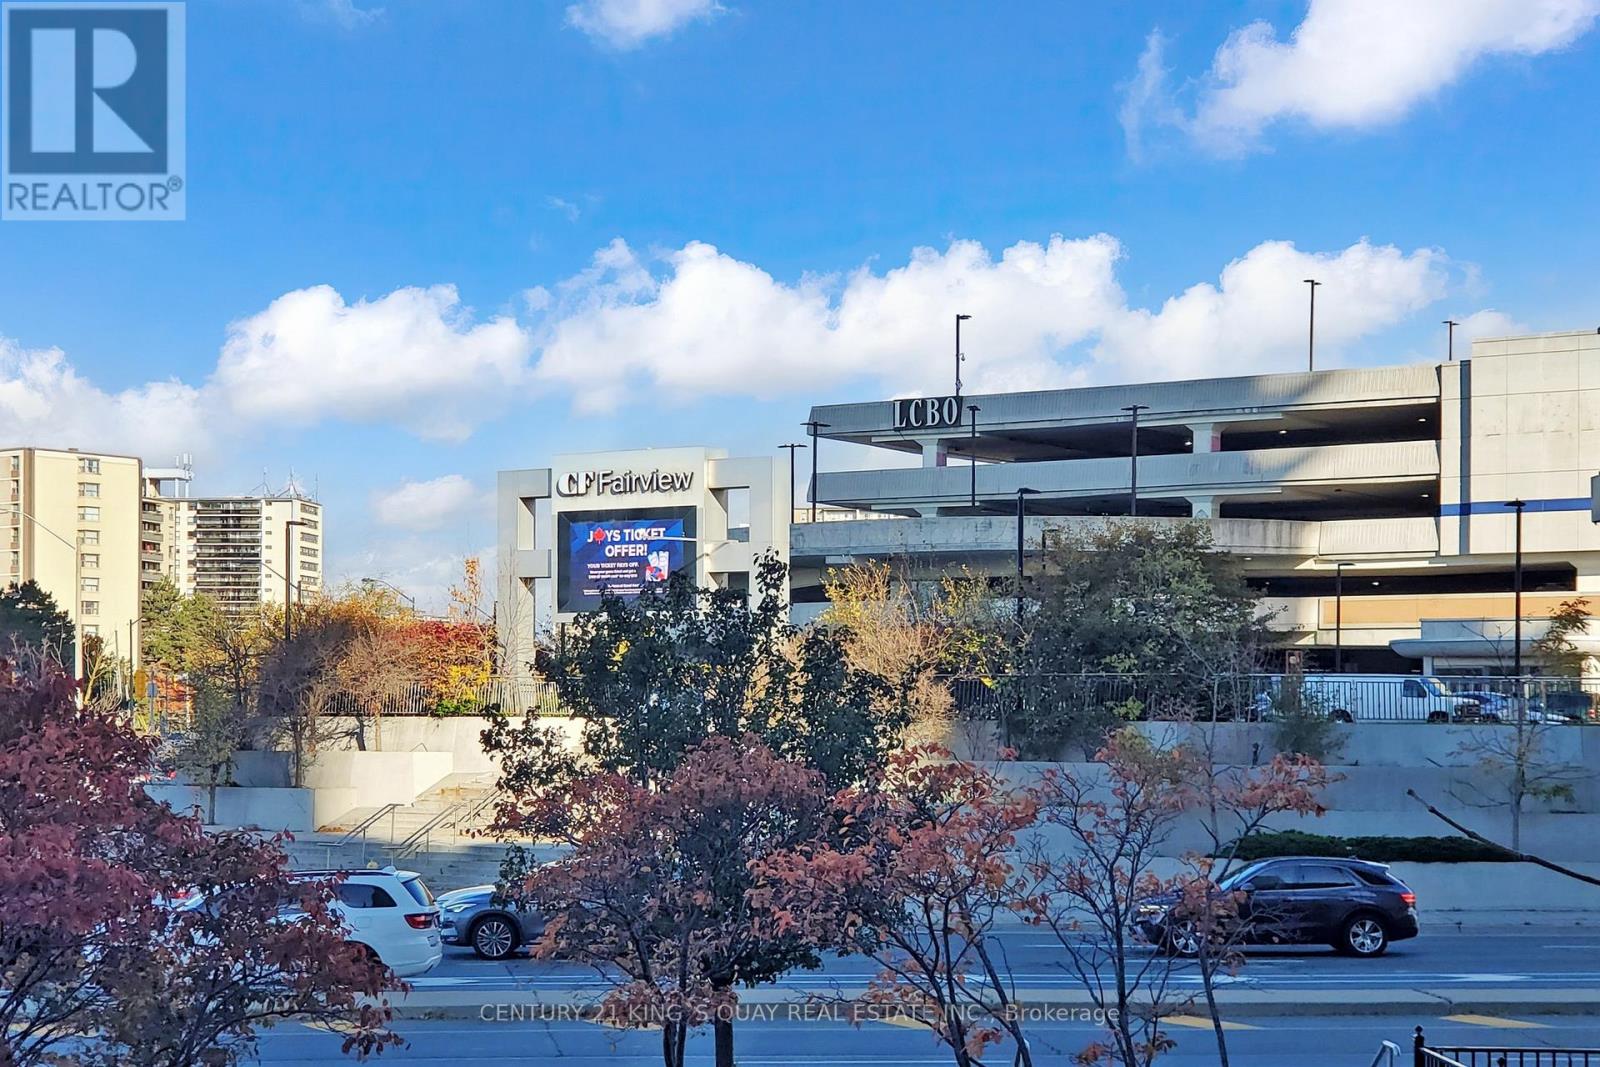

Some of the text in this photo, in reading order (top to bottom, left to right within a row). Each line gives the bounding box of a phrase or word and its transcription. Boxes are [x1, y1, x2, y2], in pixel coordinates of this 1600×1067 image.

[893, 397, 958, 428] LCBO
[556, 469, 694, 497] CF Fairview
[623, 527, 666, 542] TICKET
[605, 544, 648, 557] OFFER!
